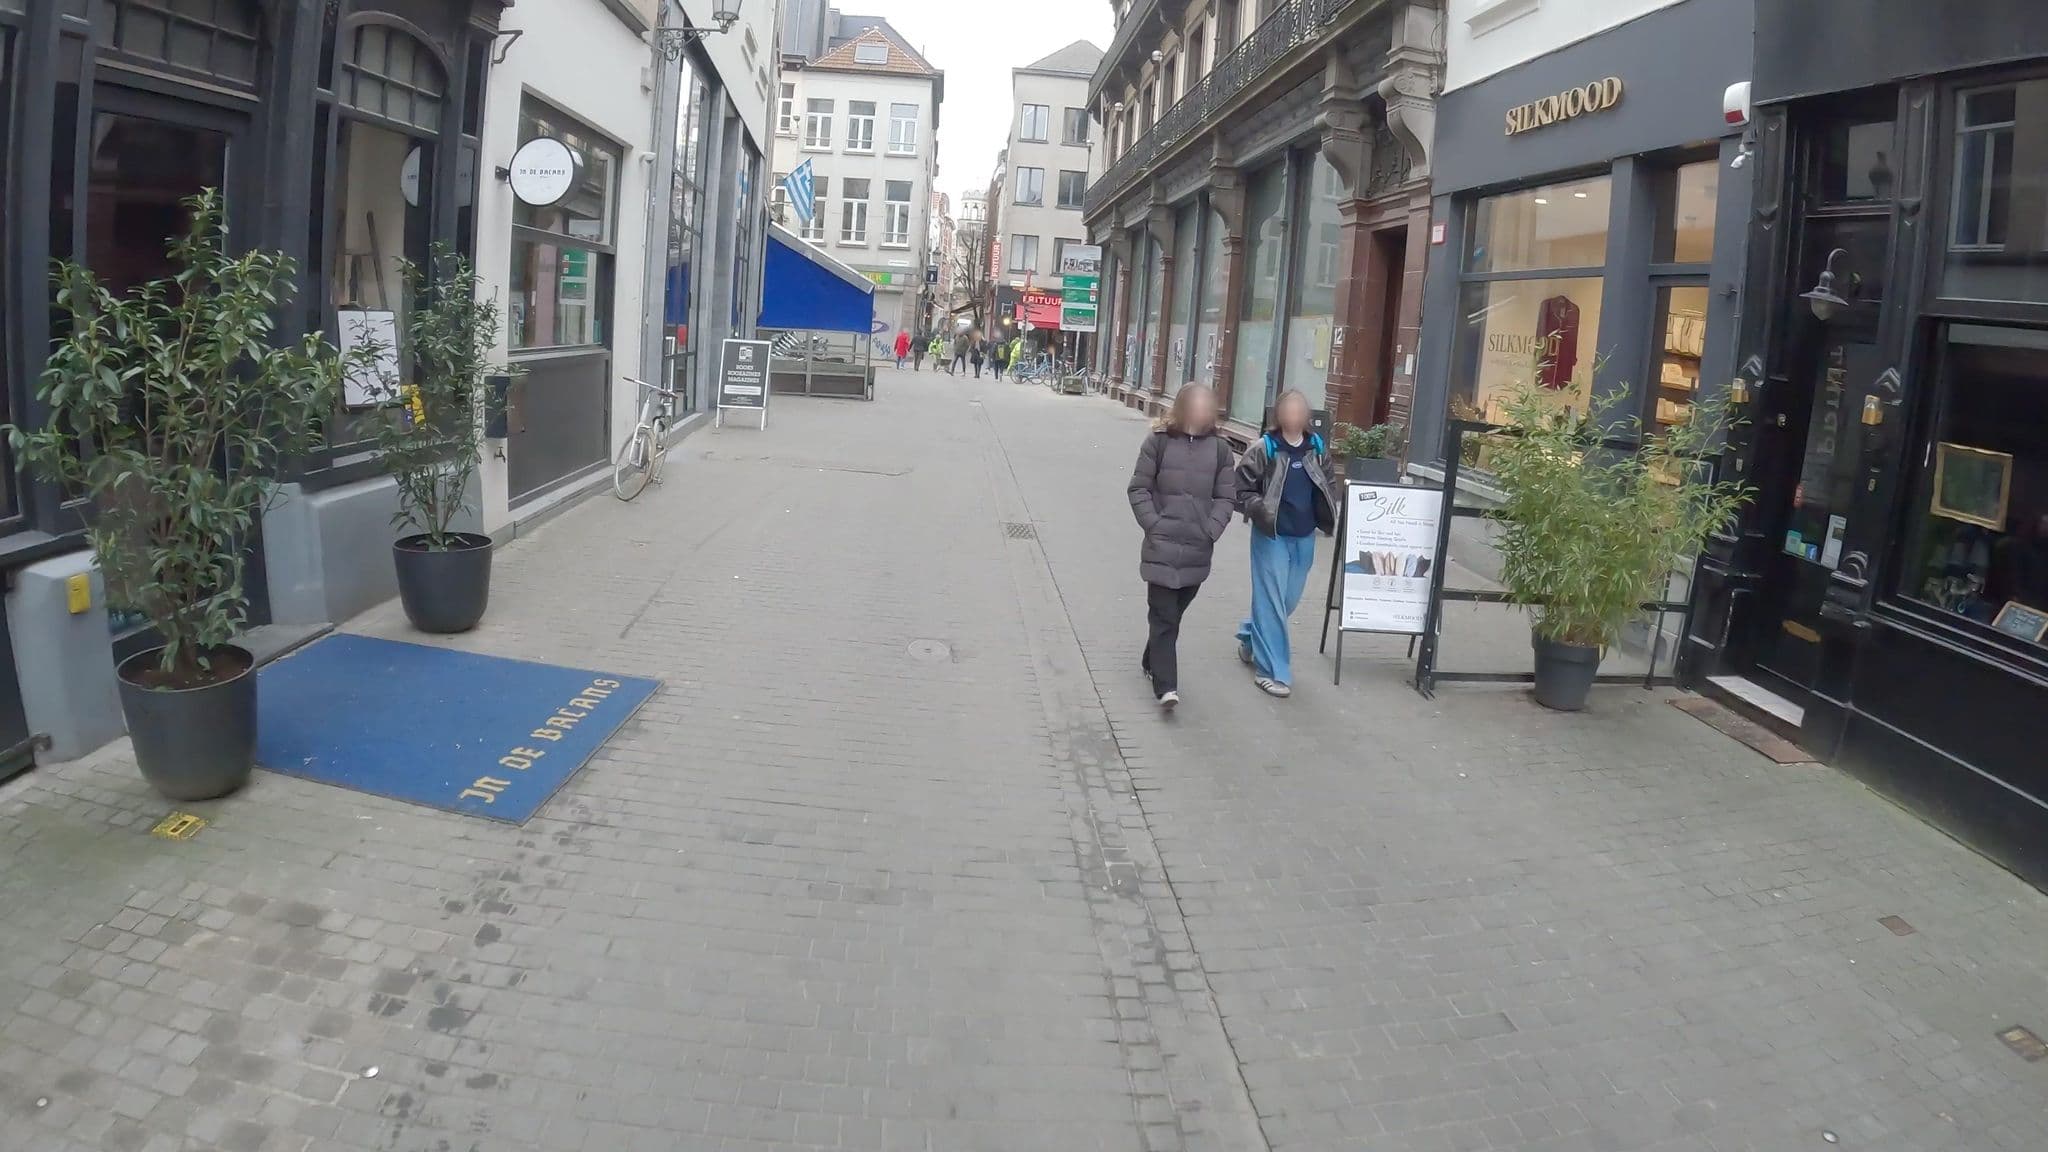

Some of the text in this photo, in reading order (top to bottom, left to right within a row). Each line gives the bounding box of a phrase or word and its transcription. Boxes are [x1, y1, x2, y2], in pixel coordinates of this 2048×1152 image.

[1504, 76, 1623, 136] SILKMOOD
[990, 244, 1000, 278] FRITUUR
[1333, 327, 1343, 345] 12
[1366, 496, 1407, 521] Silk
[499, 747, 546, 770] DE
